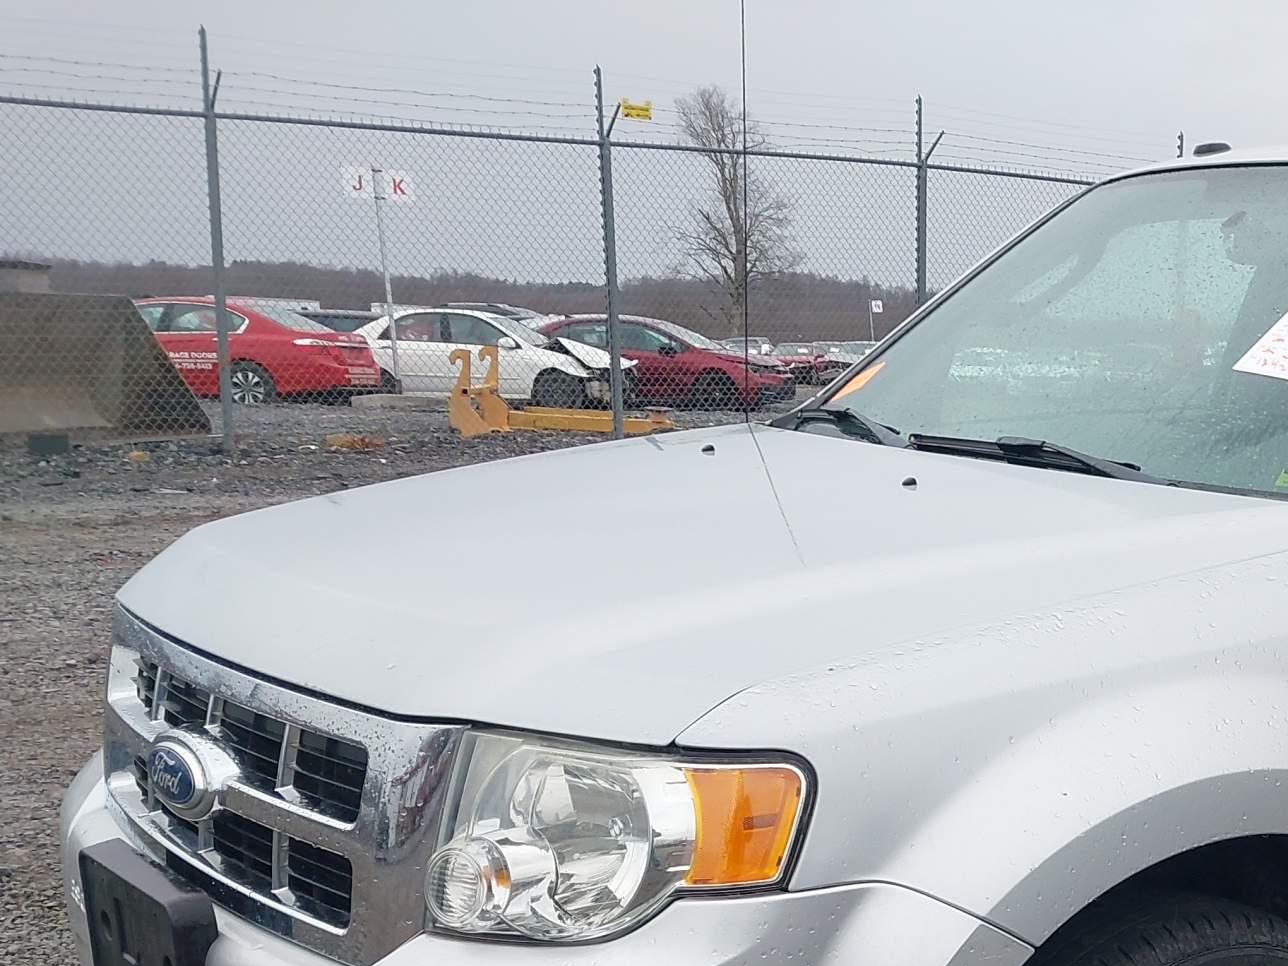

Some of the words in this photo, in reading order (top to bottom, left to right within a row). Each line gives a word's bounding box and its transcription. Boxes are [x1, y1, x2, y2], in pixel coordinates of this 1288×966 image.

[351, 175, 363, 192] J
[391, 177, 407, 196] K
[152, 751, 182, 794] Ford
